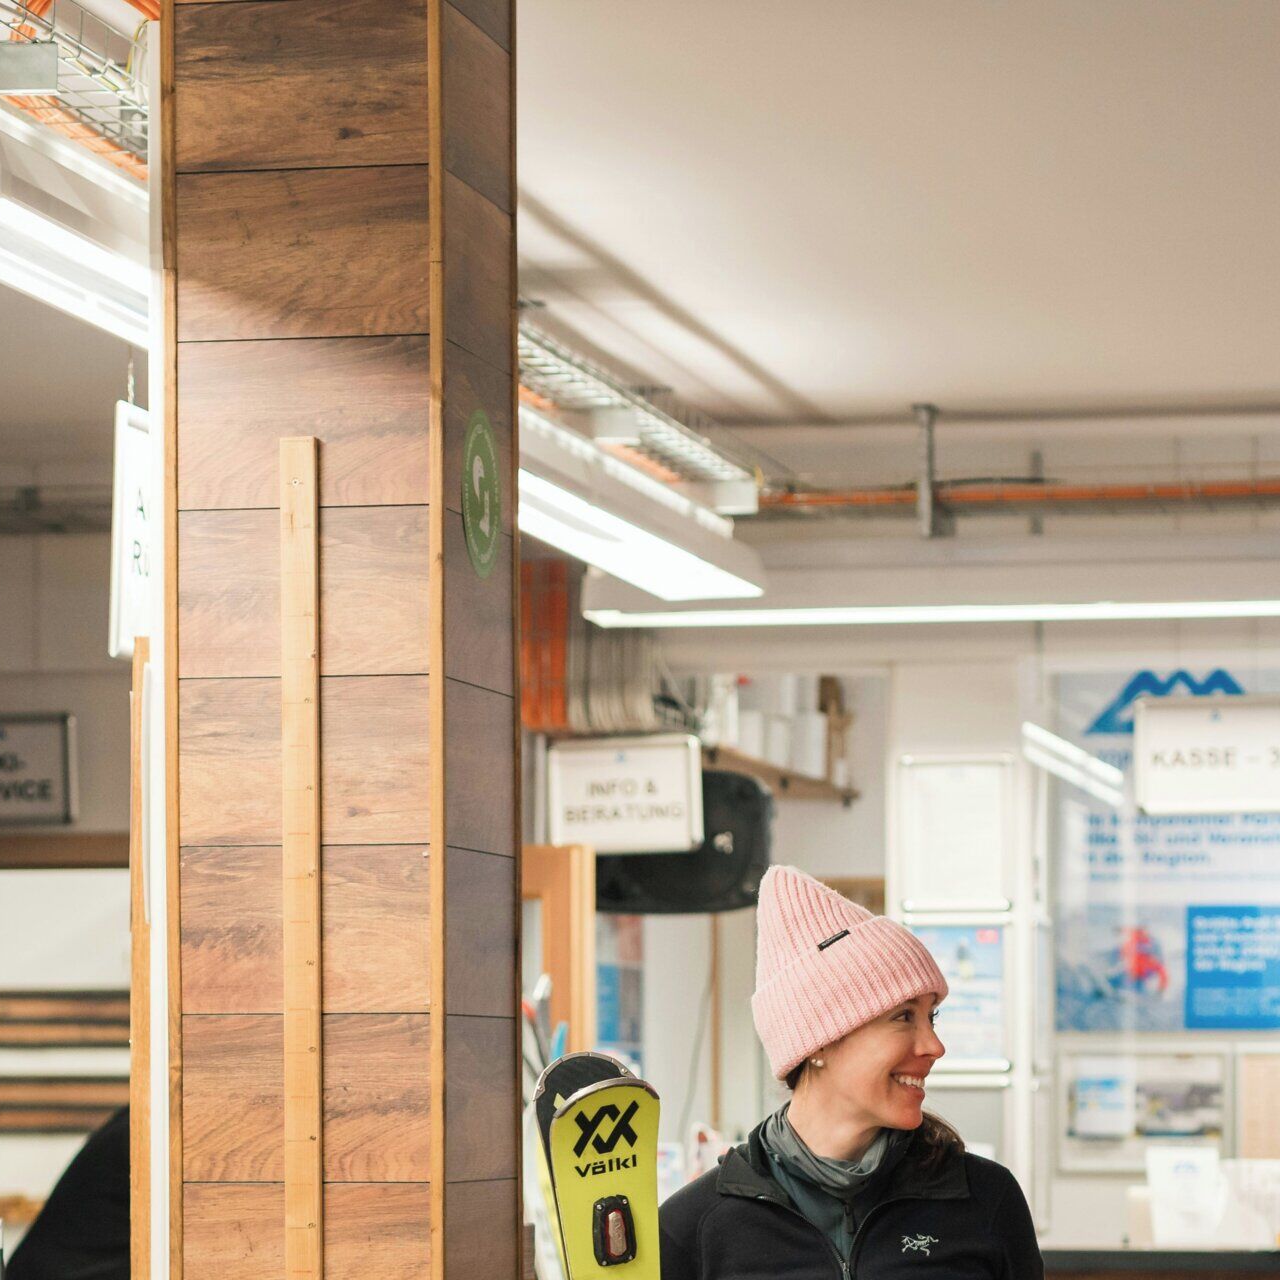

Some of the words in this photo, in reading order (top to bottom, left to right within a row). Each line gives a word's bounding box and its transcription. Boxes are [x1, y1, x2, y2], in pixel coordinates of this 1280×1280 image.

[1151, 747, 1237, 769] KASSE
[587, 778, 637, 798] INFO
[565, 802, 682, 824] BERATUNG
